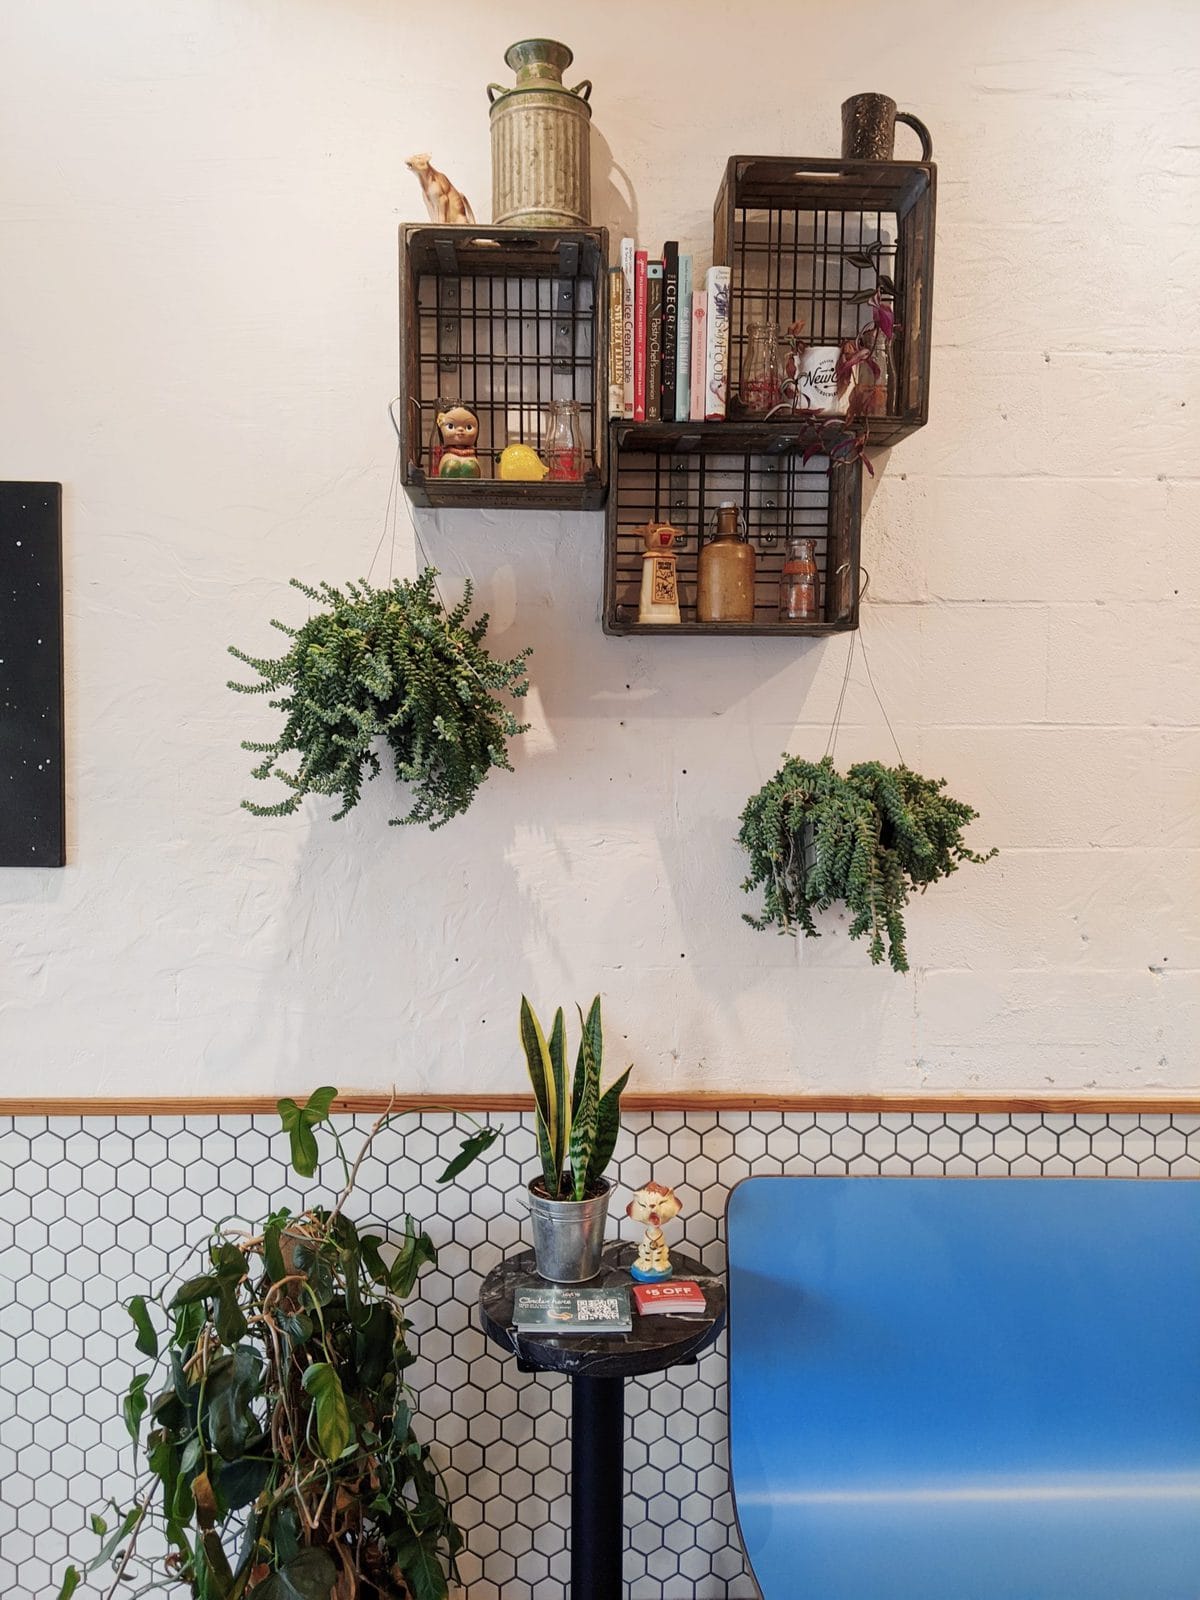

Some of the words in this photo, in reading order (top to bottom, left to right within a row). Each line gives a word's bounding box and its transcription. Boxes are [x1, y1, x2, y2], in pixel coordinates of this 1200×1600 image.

[614, 304, 623, 344] SWEET
[624, 304, 633, 319] Ice
[624, 321, 633, 357] Cream
[614, 344, 624, 385] TIMES
[624, 360, 632, 384] bible
[714, 345, 727, 382] FOOD
[551, 1296, 572, 1305] here
[645, 1288, 660, 1296] $5
[662, 1287, 691, 1295] OFF
